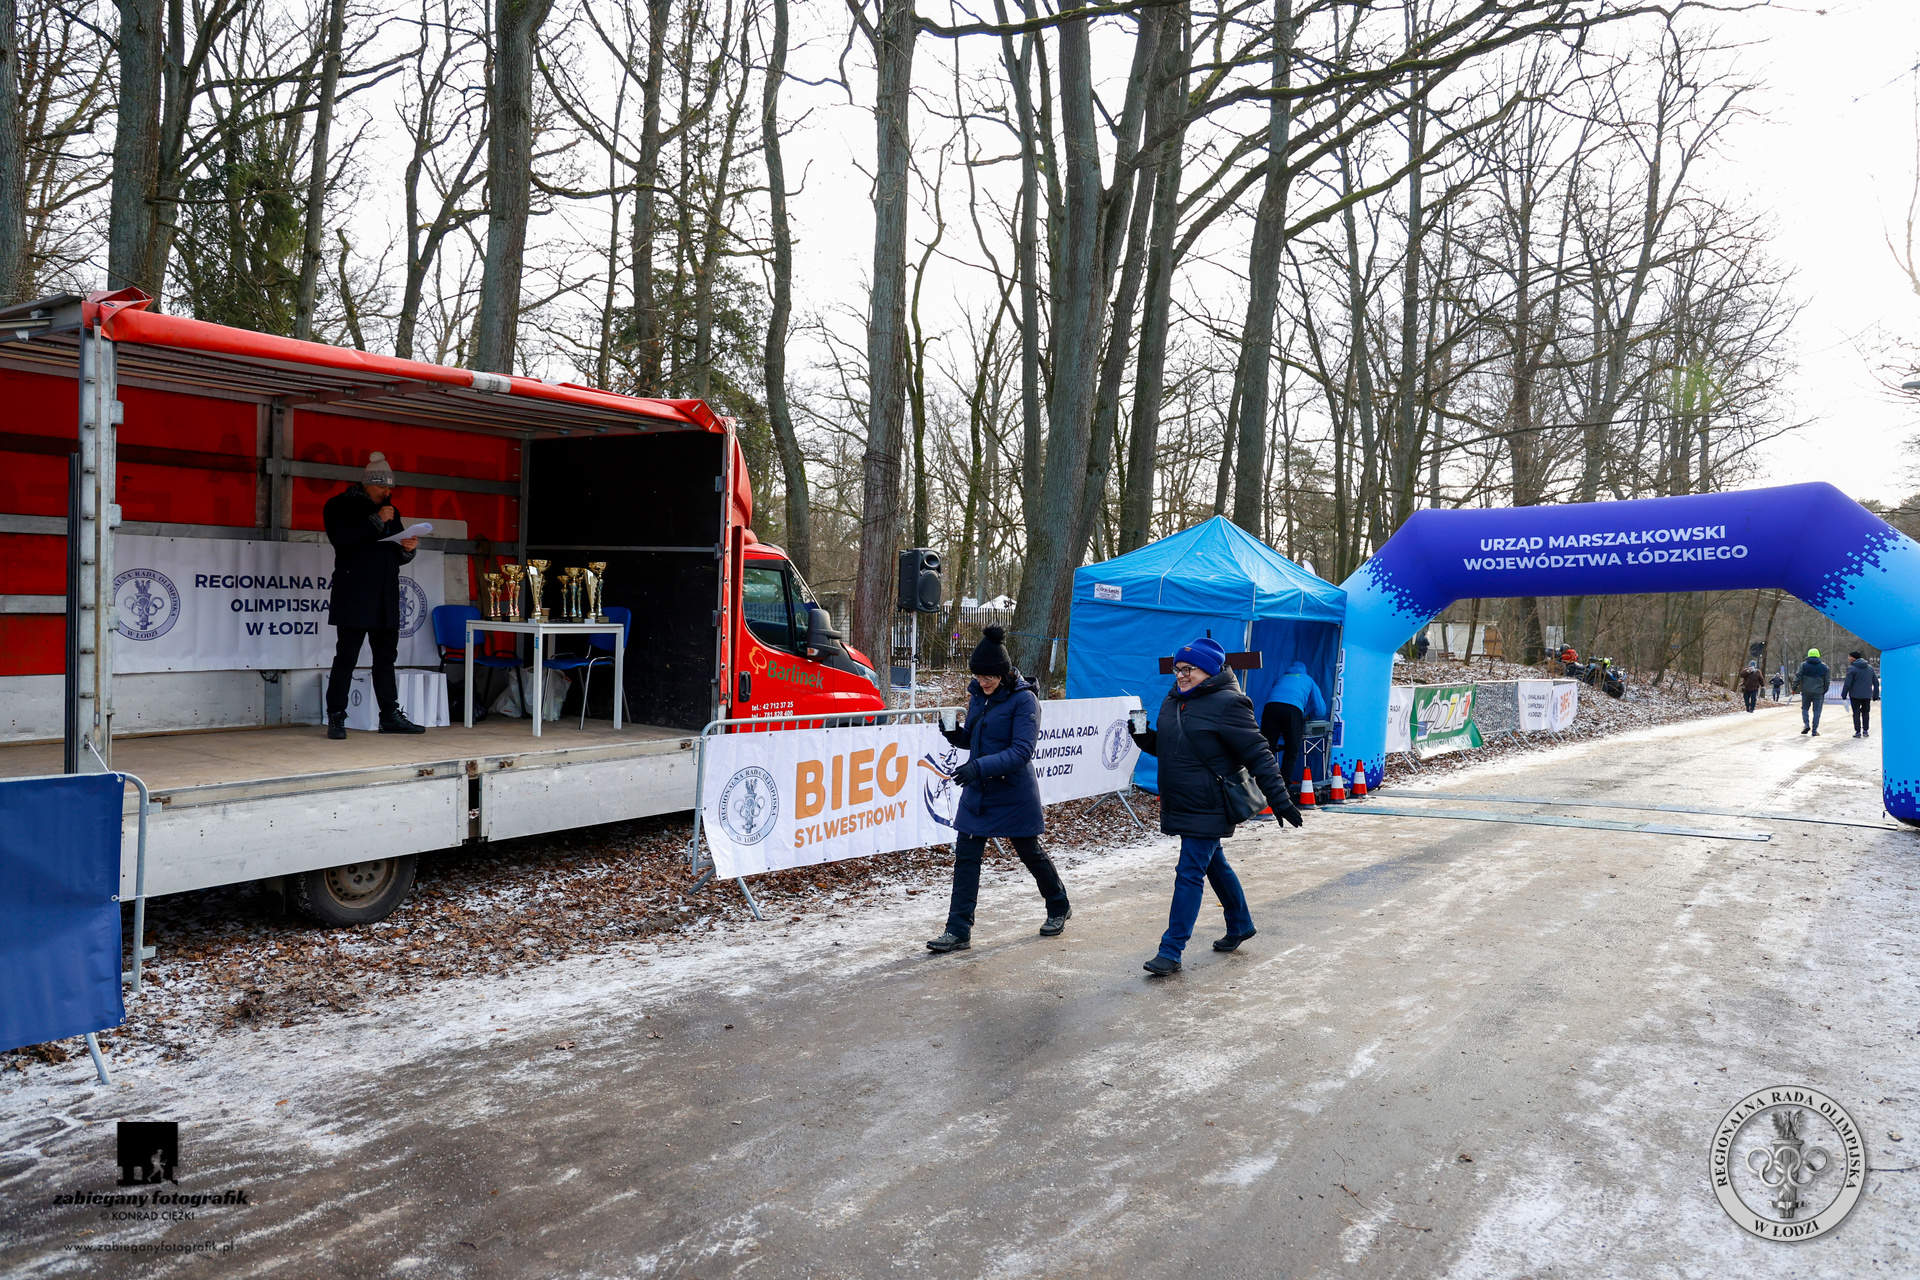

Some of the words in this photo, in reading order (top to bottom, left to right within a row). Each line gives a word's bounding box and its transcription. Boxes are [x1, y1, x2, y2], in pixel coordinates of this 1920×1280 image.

[1480, 537, 1544, 553] URZĄD
[1549, 525, 1727, 548] MARSZAŁKOWSKI
[1464, 552, 1622, 570] WOJEWÓDZTWA
[1626, 544, 1748, 564] ŁÓDZKIEGO
[195, 574, 313, 590] REGIONALNA
[231, 599, 330, 612] OLIMPIJSKA
[246, 622, 263, 635] W
[268, 621, 318, 635] ŁODZI
[768, 660, 824, 689] Barlinek
[1037, 728, 1074, 741] ONALNA
[1077, 726, 1099, 737] RADA
[795, 742, 908, 820] BIEG
[1036, 767, 1045, 778] W
[1047, 764, 1074, 777] ŁODZI
[794, 800, 908, 849] SYLWESTROWY
